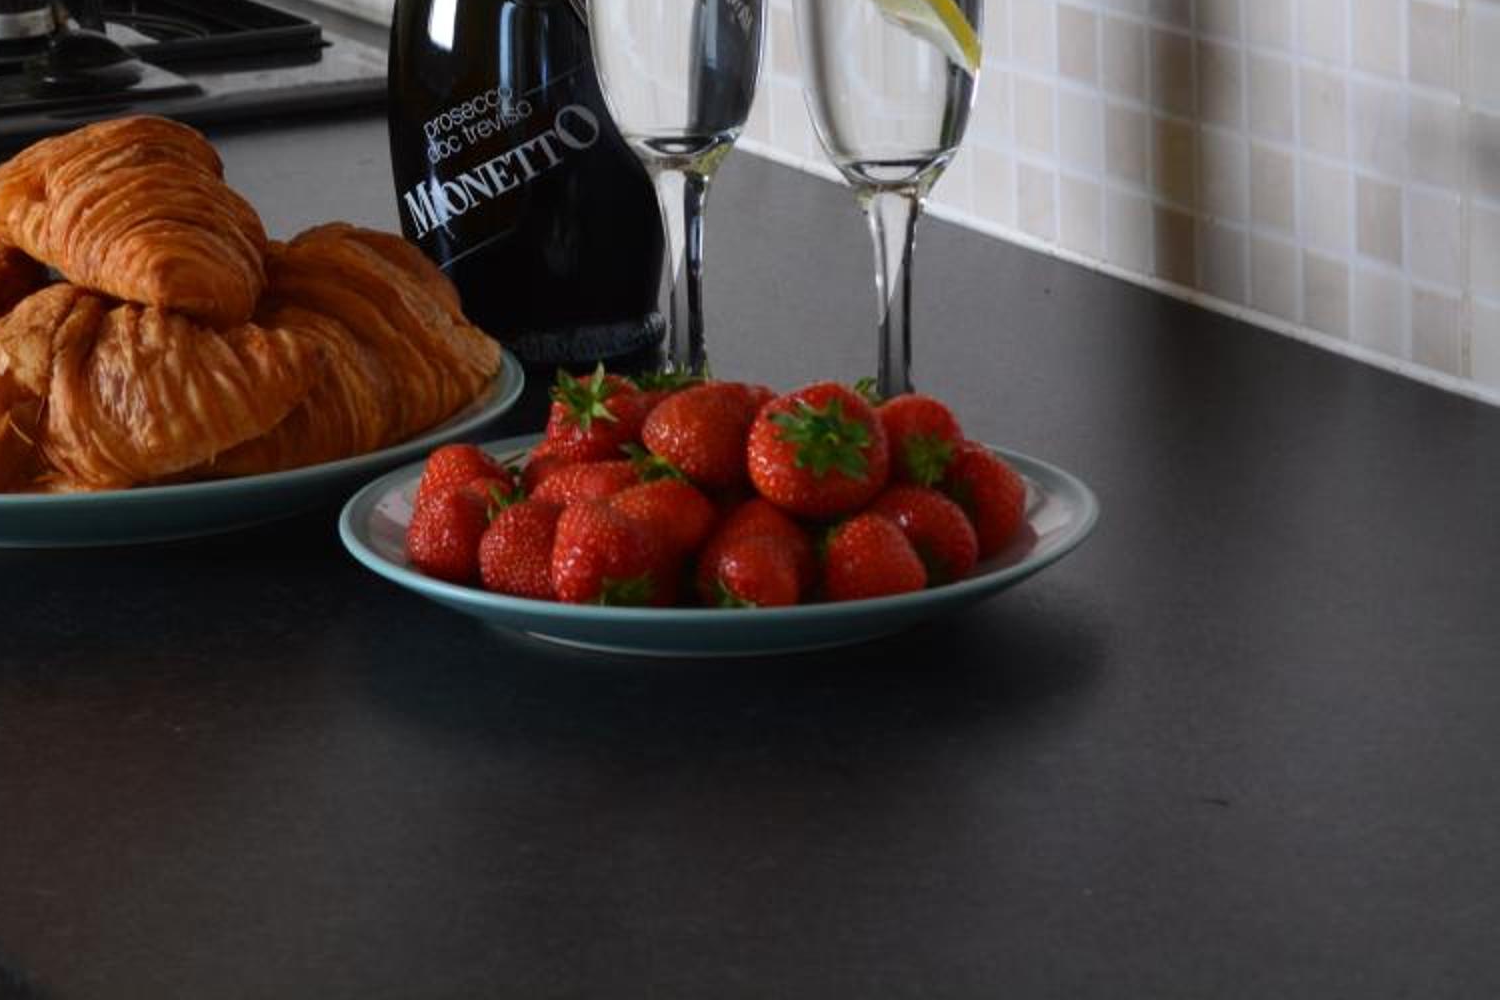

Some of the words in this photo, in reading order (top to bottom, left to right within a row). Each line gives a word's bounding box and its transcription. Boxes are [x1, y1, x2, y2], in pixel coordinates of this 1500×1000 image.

[424, 86, 513, 139] prosecco
[427, 135, 462, 164] doc
[463, 100, 532, 145] treviso
[404, 104, 599, 240] MONETTO
